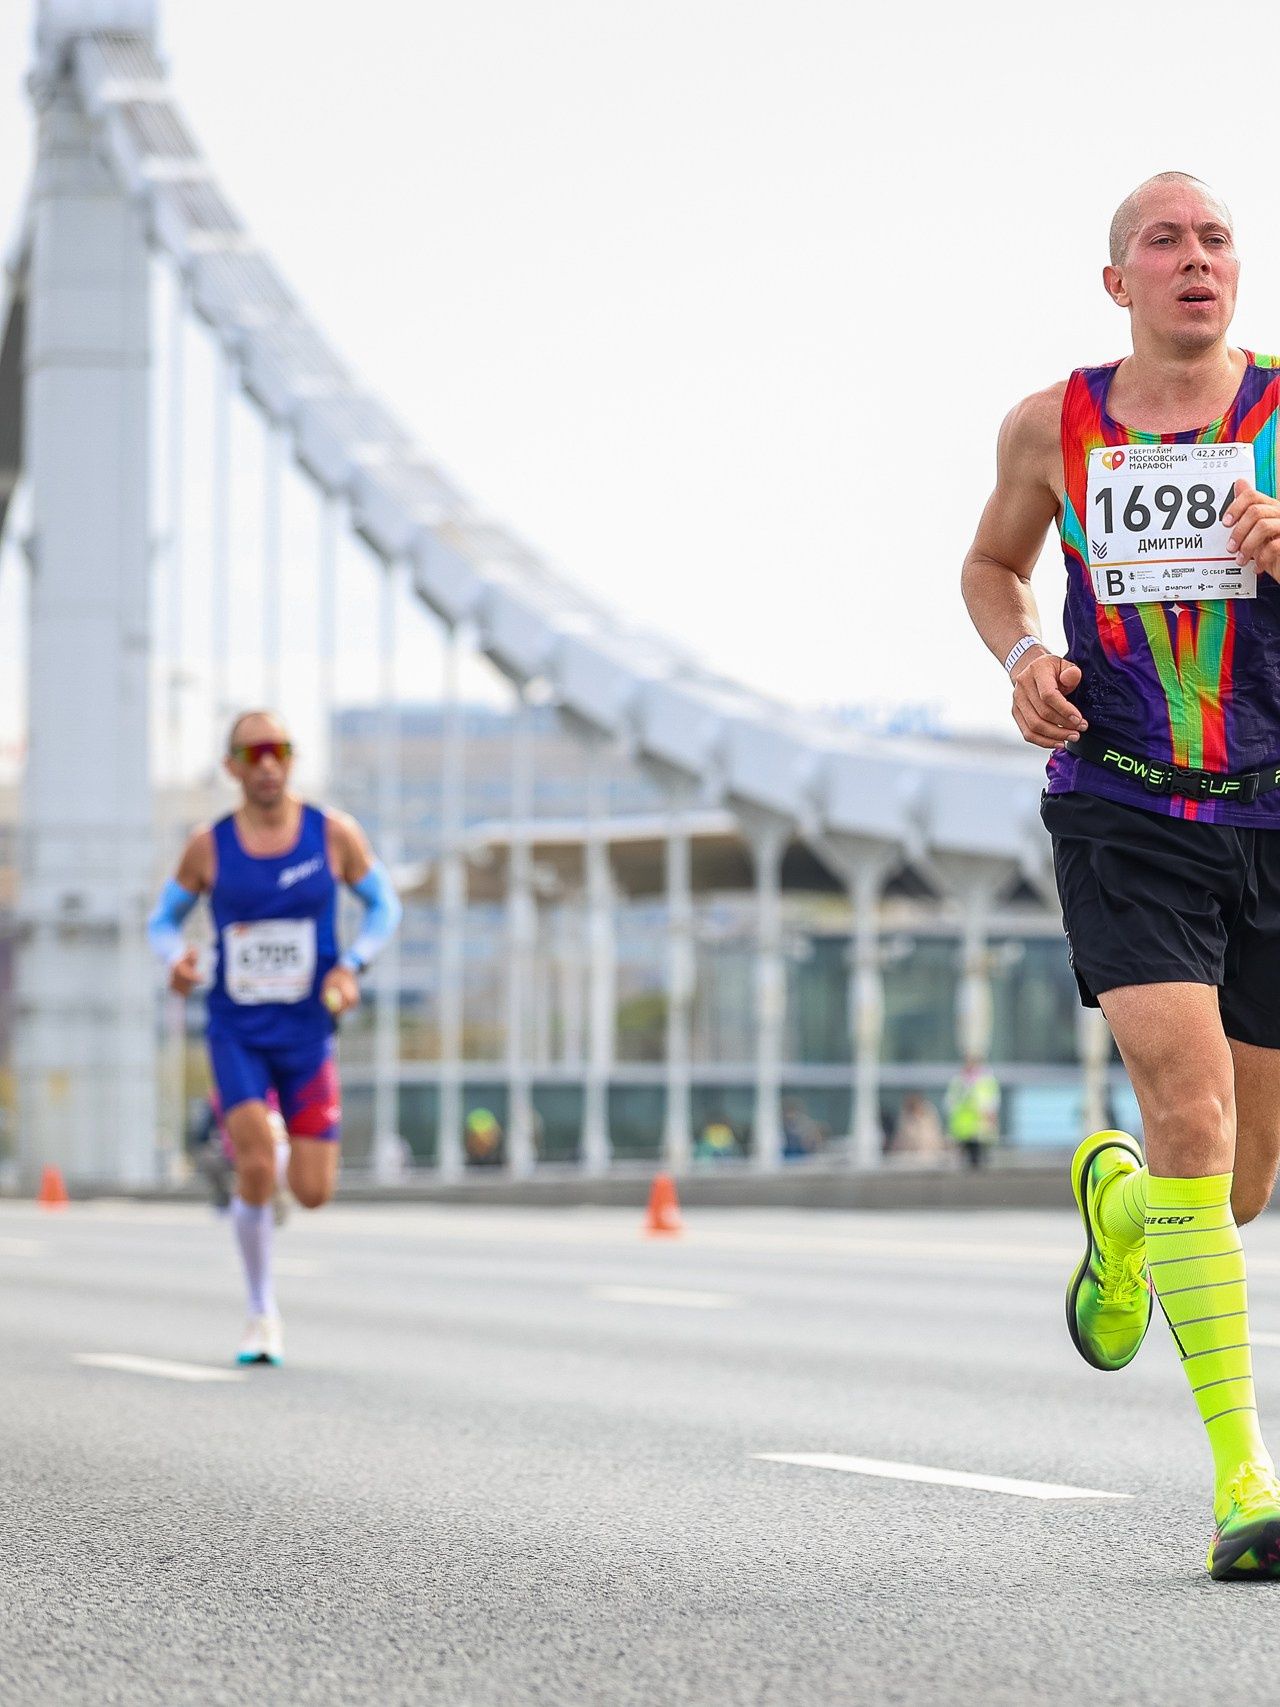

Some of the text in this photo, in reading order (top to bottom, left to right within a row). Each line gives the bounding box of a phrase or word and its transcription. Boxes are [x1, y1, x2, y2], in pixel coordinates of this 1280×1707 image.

[1129, 454, 1188, 462] МОСКОВСКИЙ
[1129, 462, 1173, 470] МАРАФОН
[1138, 534, 1203, 554] ДМИТРИЙ
